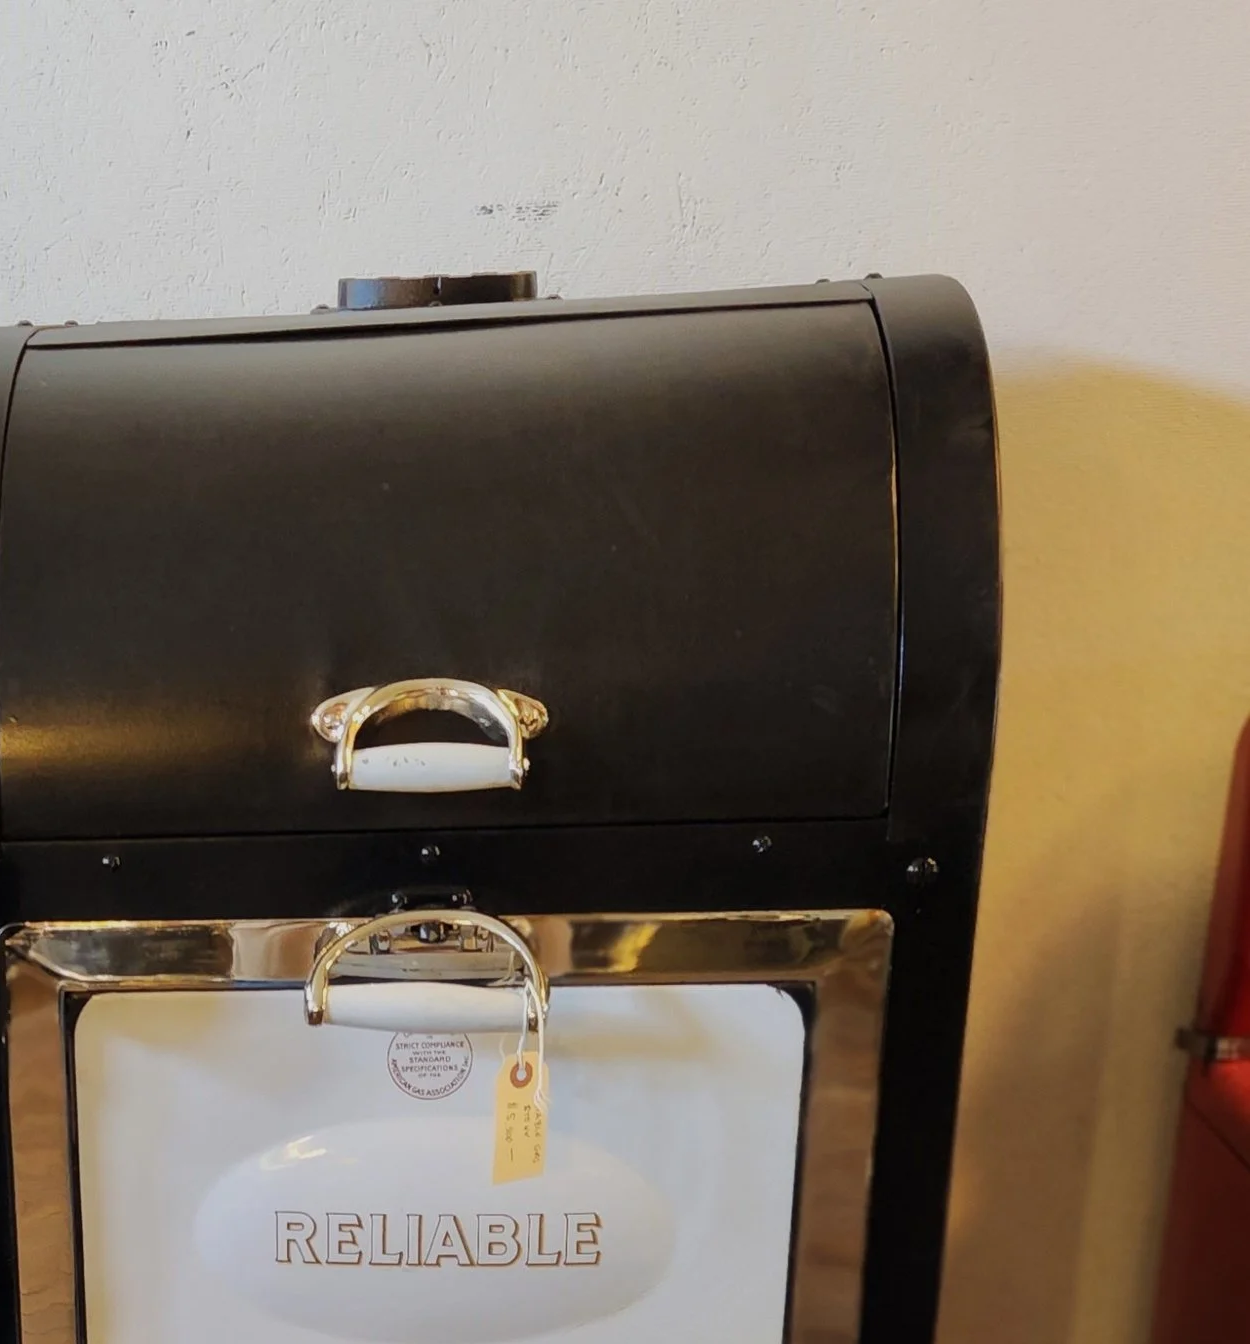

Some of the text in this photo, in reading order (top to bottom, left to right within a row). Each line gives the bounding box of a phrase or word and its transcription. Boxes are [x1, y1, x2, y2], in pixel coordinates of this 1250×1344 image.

[395, 1041, 464, 1050] STRICT COMPLIANCE
[409, 1055, 451, 1063] STANDARD
[401, 1064, 458, 1072] SPECIFICATIONS
[391, 1058, 411, 1090] AMERICAN
[411, 1086, 426, 1096] GAS
[425, 1066, 467, 1097] ASSOCIATION
[275, 1210, 603, 1268] RELIABLE
